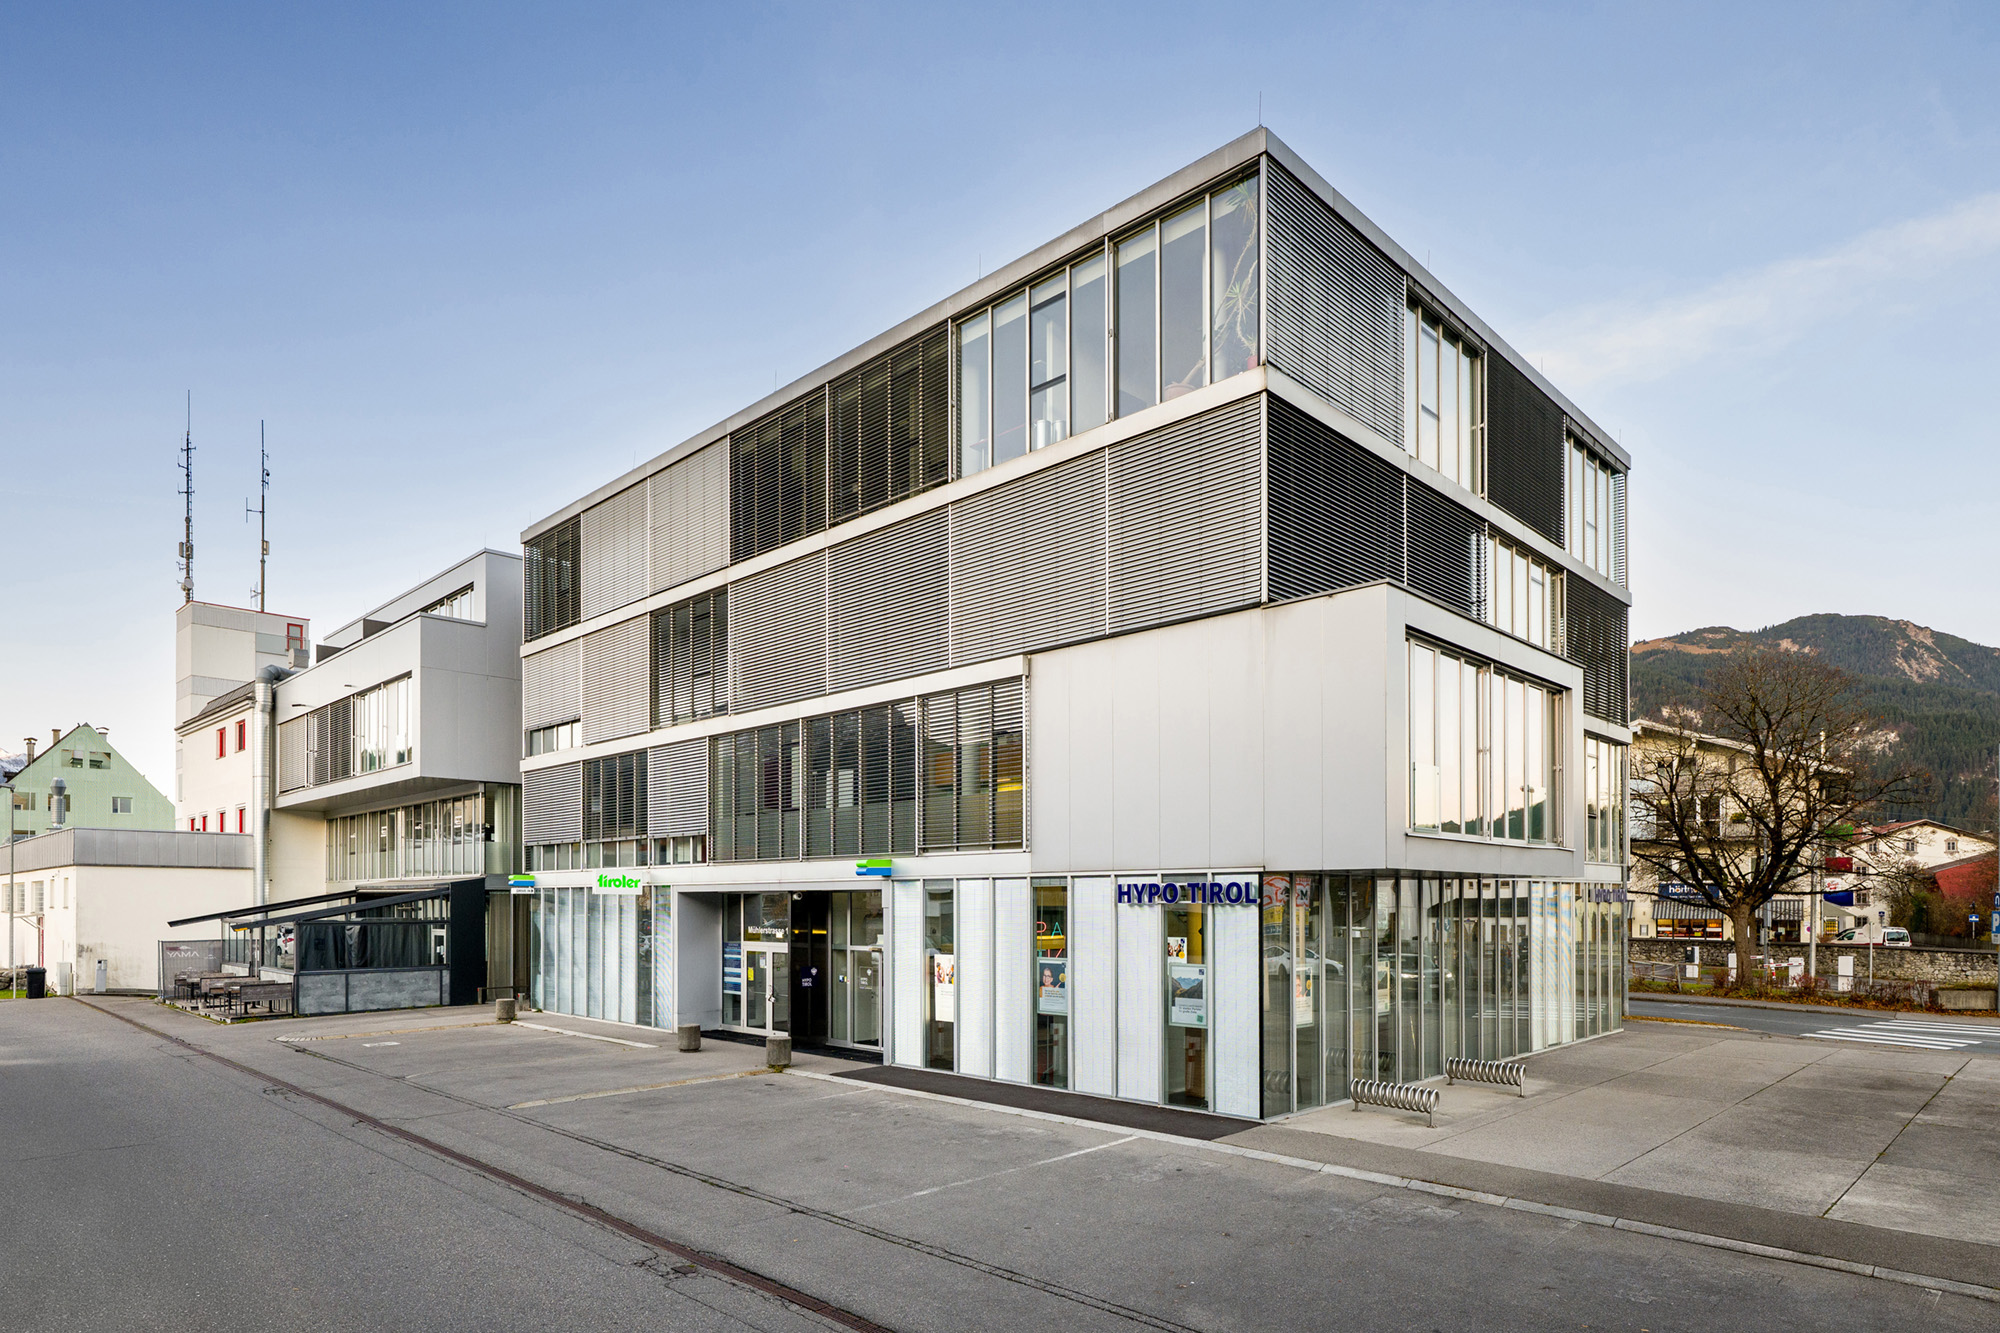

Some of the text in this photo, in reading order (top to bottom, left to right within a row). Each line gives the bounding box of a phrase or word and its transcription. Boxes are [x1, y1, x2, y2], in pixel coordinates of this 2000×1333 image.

[597, 874, 641, 888] tiroler
[1117, 882, 1258, 904] HYPO TIROL
[748, 926, 784, 935] Mühlerstrasse
